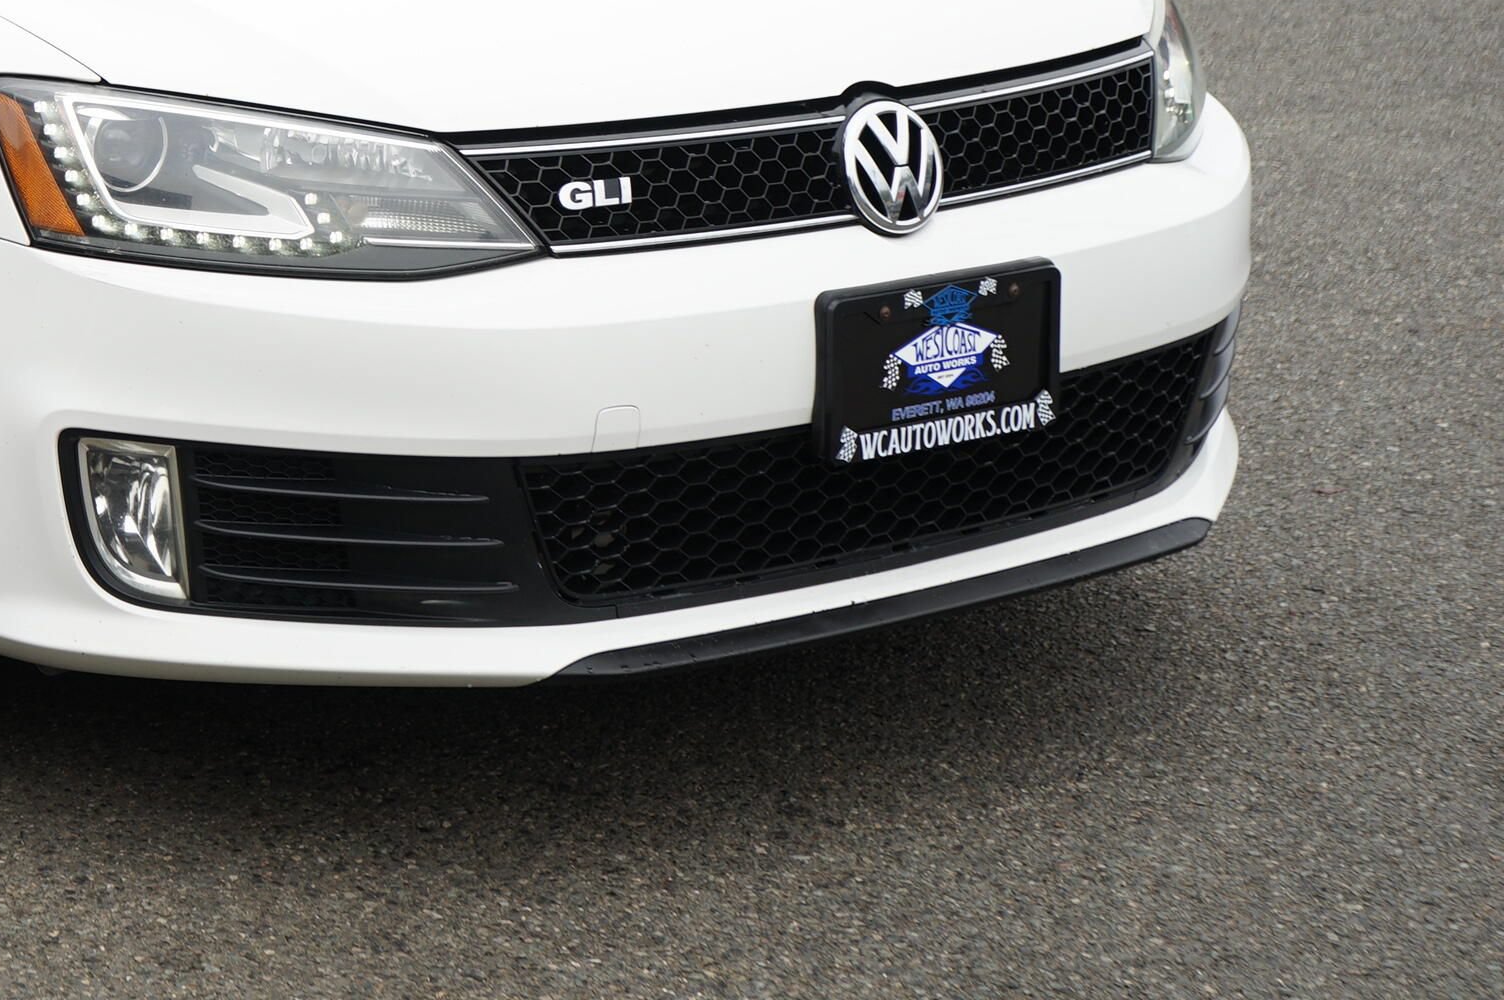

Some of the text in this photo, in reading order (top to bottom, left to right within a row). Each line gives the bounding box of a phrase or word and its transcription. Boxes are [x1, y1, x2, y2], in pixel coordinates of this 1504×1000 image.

[558, 176, 633, 211] GLI
[914, 355, 977, 375] AUTO WORKS
[891, 400, 944, 422] EVERETT,
[944, 396, 965, 411] WA
[859, 403, 1035, 460] WCAUTOWORKS.COM
